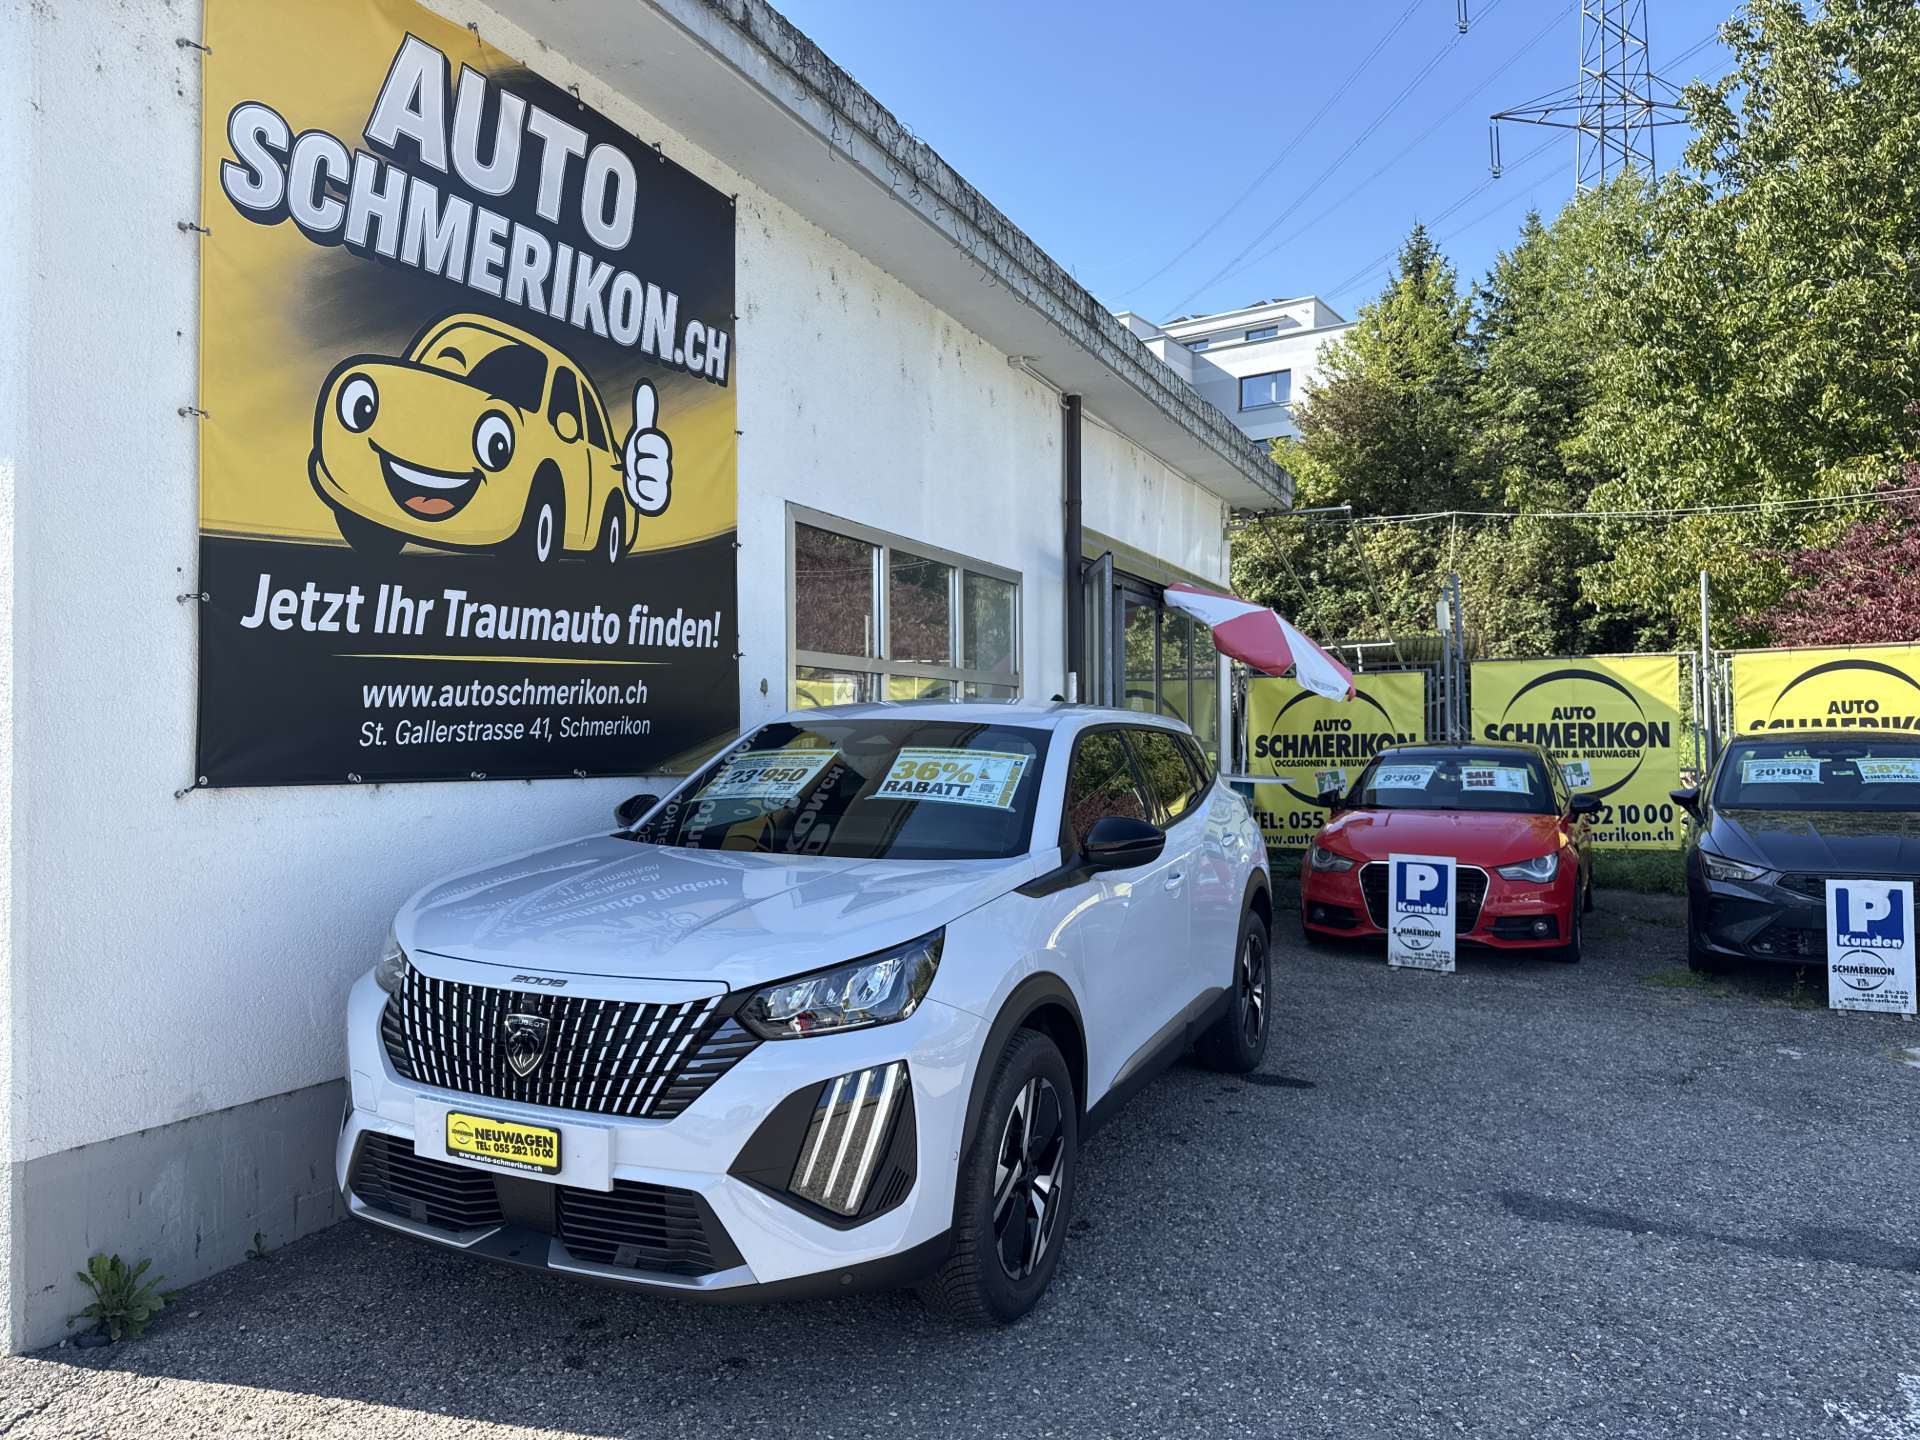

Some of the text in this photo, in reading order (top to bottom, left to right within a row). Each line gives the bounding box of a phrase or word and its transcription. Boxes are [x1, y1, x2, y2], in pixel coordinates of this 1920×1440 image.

[365, 34, 638, 250] AUTO
[222, 103, 728, 382] SCHMERIKON.CH
[240, 573, 722, 649] Jetzt Ihr Traumauto finden!
[362, 678, 648, 709] www.autoschmerikon.ch
[1551, 706, 1596, 720] AUTO
[1827, 700, 1879, 714] AUTO
[359, 716, 651, 747] St. Gallerstrasse 41, Schmerikon
[1313, 718, 1352, 732] AUTO
[1483, 721, 1670, 748] SCHMERIKON
[1583, 749, 1640, 758] NEUWAGEN
[890, 760, 975, 784] 36%
[1274, 759, 1327, 768] OCCASIONEN
[726, 767, 808, 785] 23'950
[882, 780, 970, 797] RABATT
[1289, 811, 1324, 829] 055
[1406, 864, 1439, 900] P
[1398, 902, 1446, 915] Kunden
[1839, 934, 1903, 949] Kunden
[1832, 965, 1895, 976] SCHMERIKON
[511, 974, 568, 987] 2008
[474, 1128, 553, 1149] NEUWAGEN
[475, 1141, 554, 1159] TEL: 055 282 10 00
[458, 1150, 543, 1173] www.auto-schmerikon.ch
